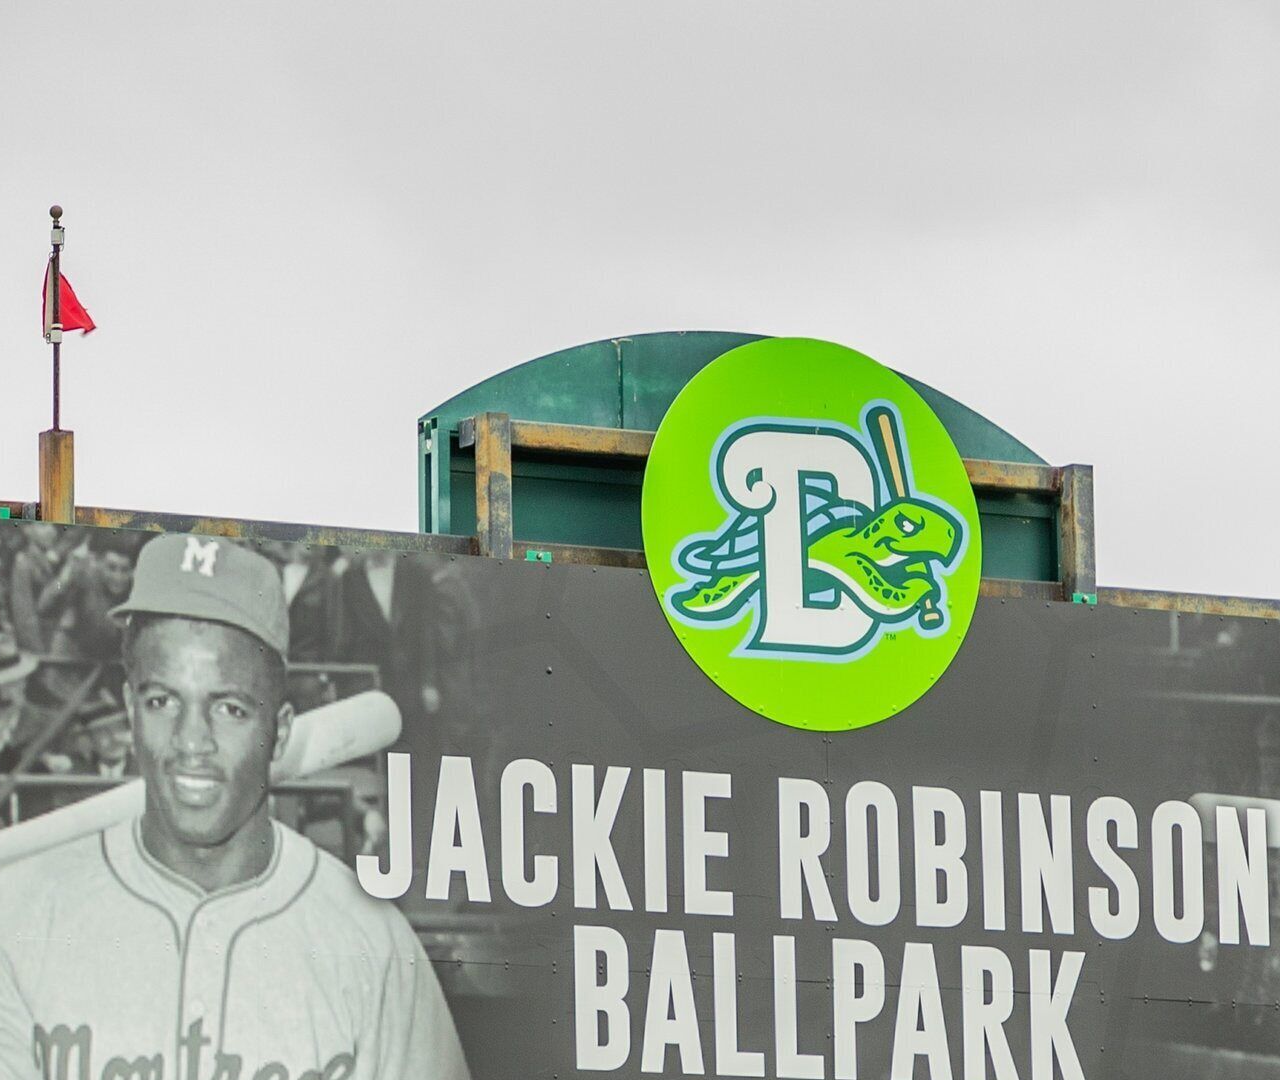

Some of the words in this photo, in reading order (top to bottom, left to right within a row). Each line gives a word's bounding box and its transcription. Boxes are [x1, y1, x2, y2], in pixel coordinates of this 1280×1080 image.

[180, 536, 220, 577] M
[884, 633, 897, 641] TM
[356, 752, 734, 916] JACKIE
[778, 777, 1271, 946] ROBINSON
